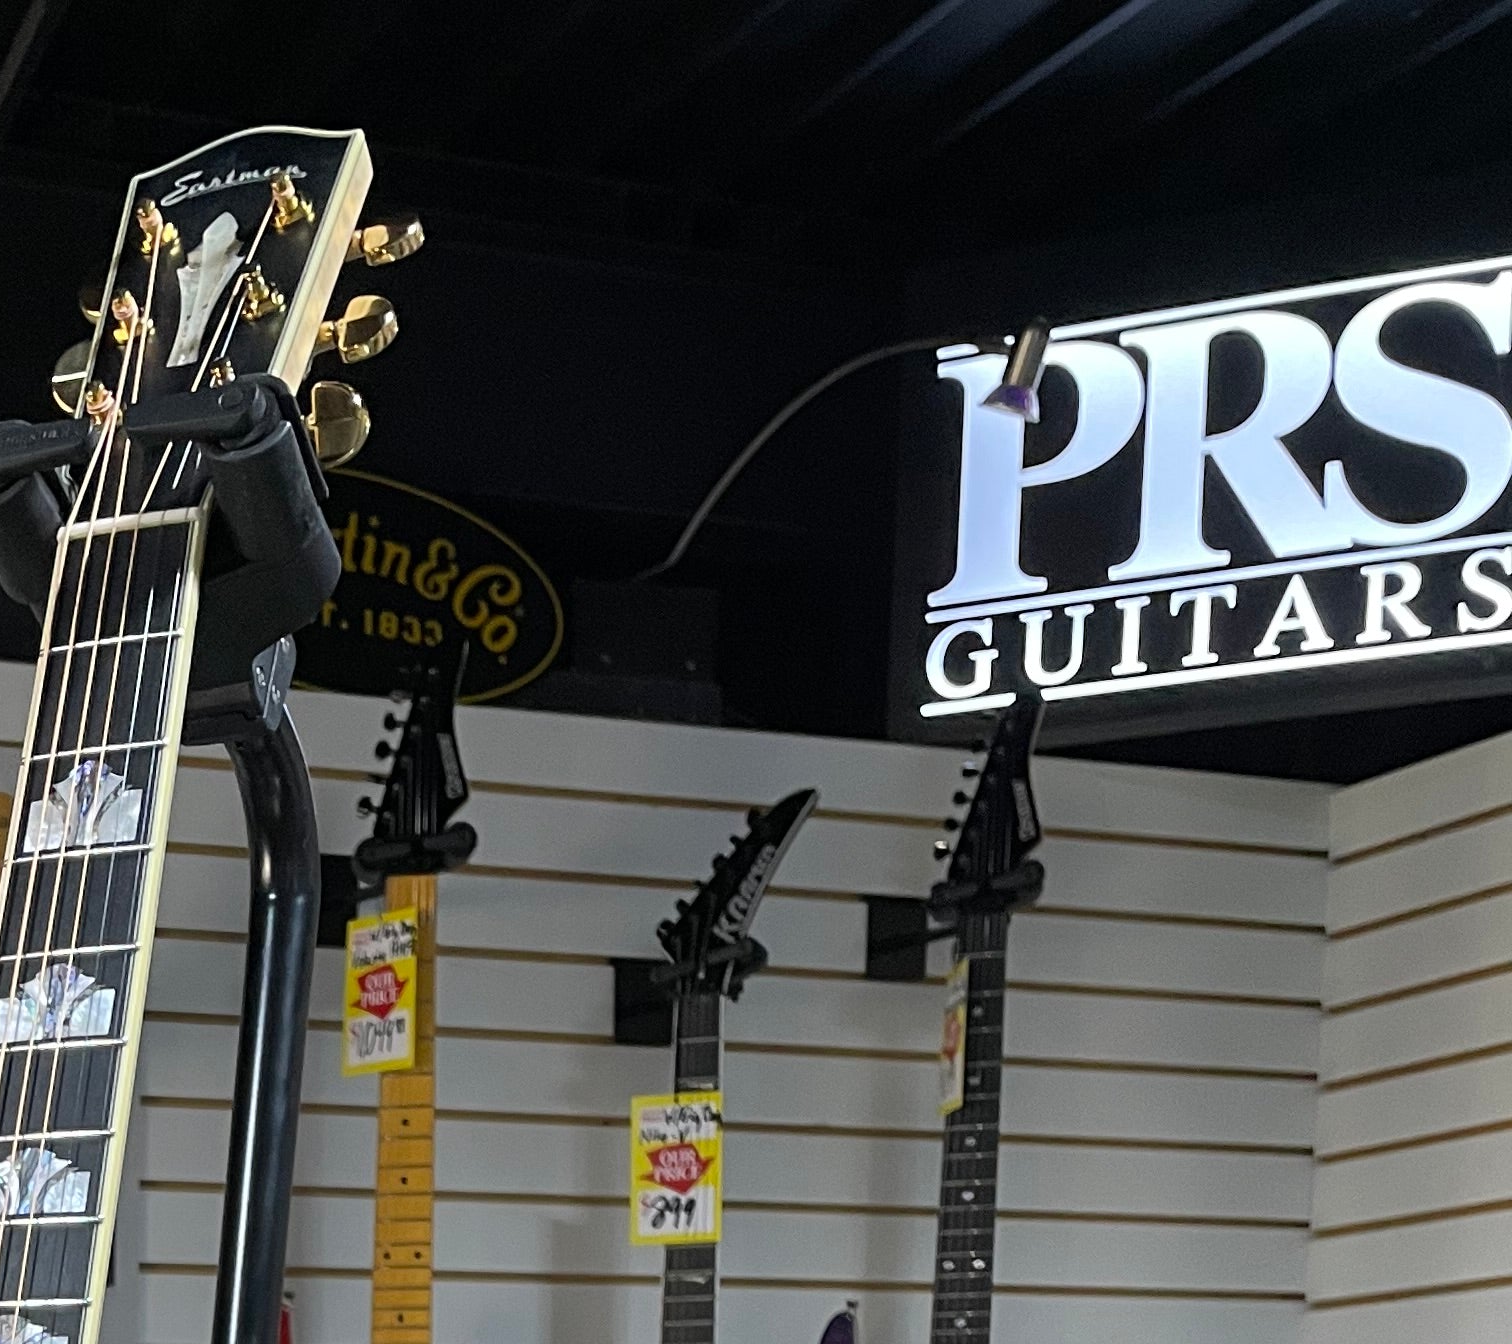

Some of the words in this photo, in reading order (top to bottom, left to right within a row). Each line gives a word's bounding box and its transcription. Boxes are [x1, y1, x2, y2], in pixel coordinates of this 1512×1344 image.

[160, 164, 308, 207] Eastman
[926, 270, 1512, 607] PRS
[363, 607, 443, 648] 1833
[924, 545, 1512, 701] GUITARS
[653, 1163, 702, 1182] PRICE
[658, 1149, 698, 1166] OUR
